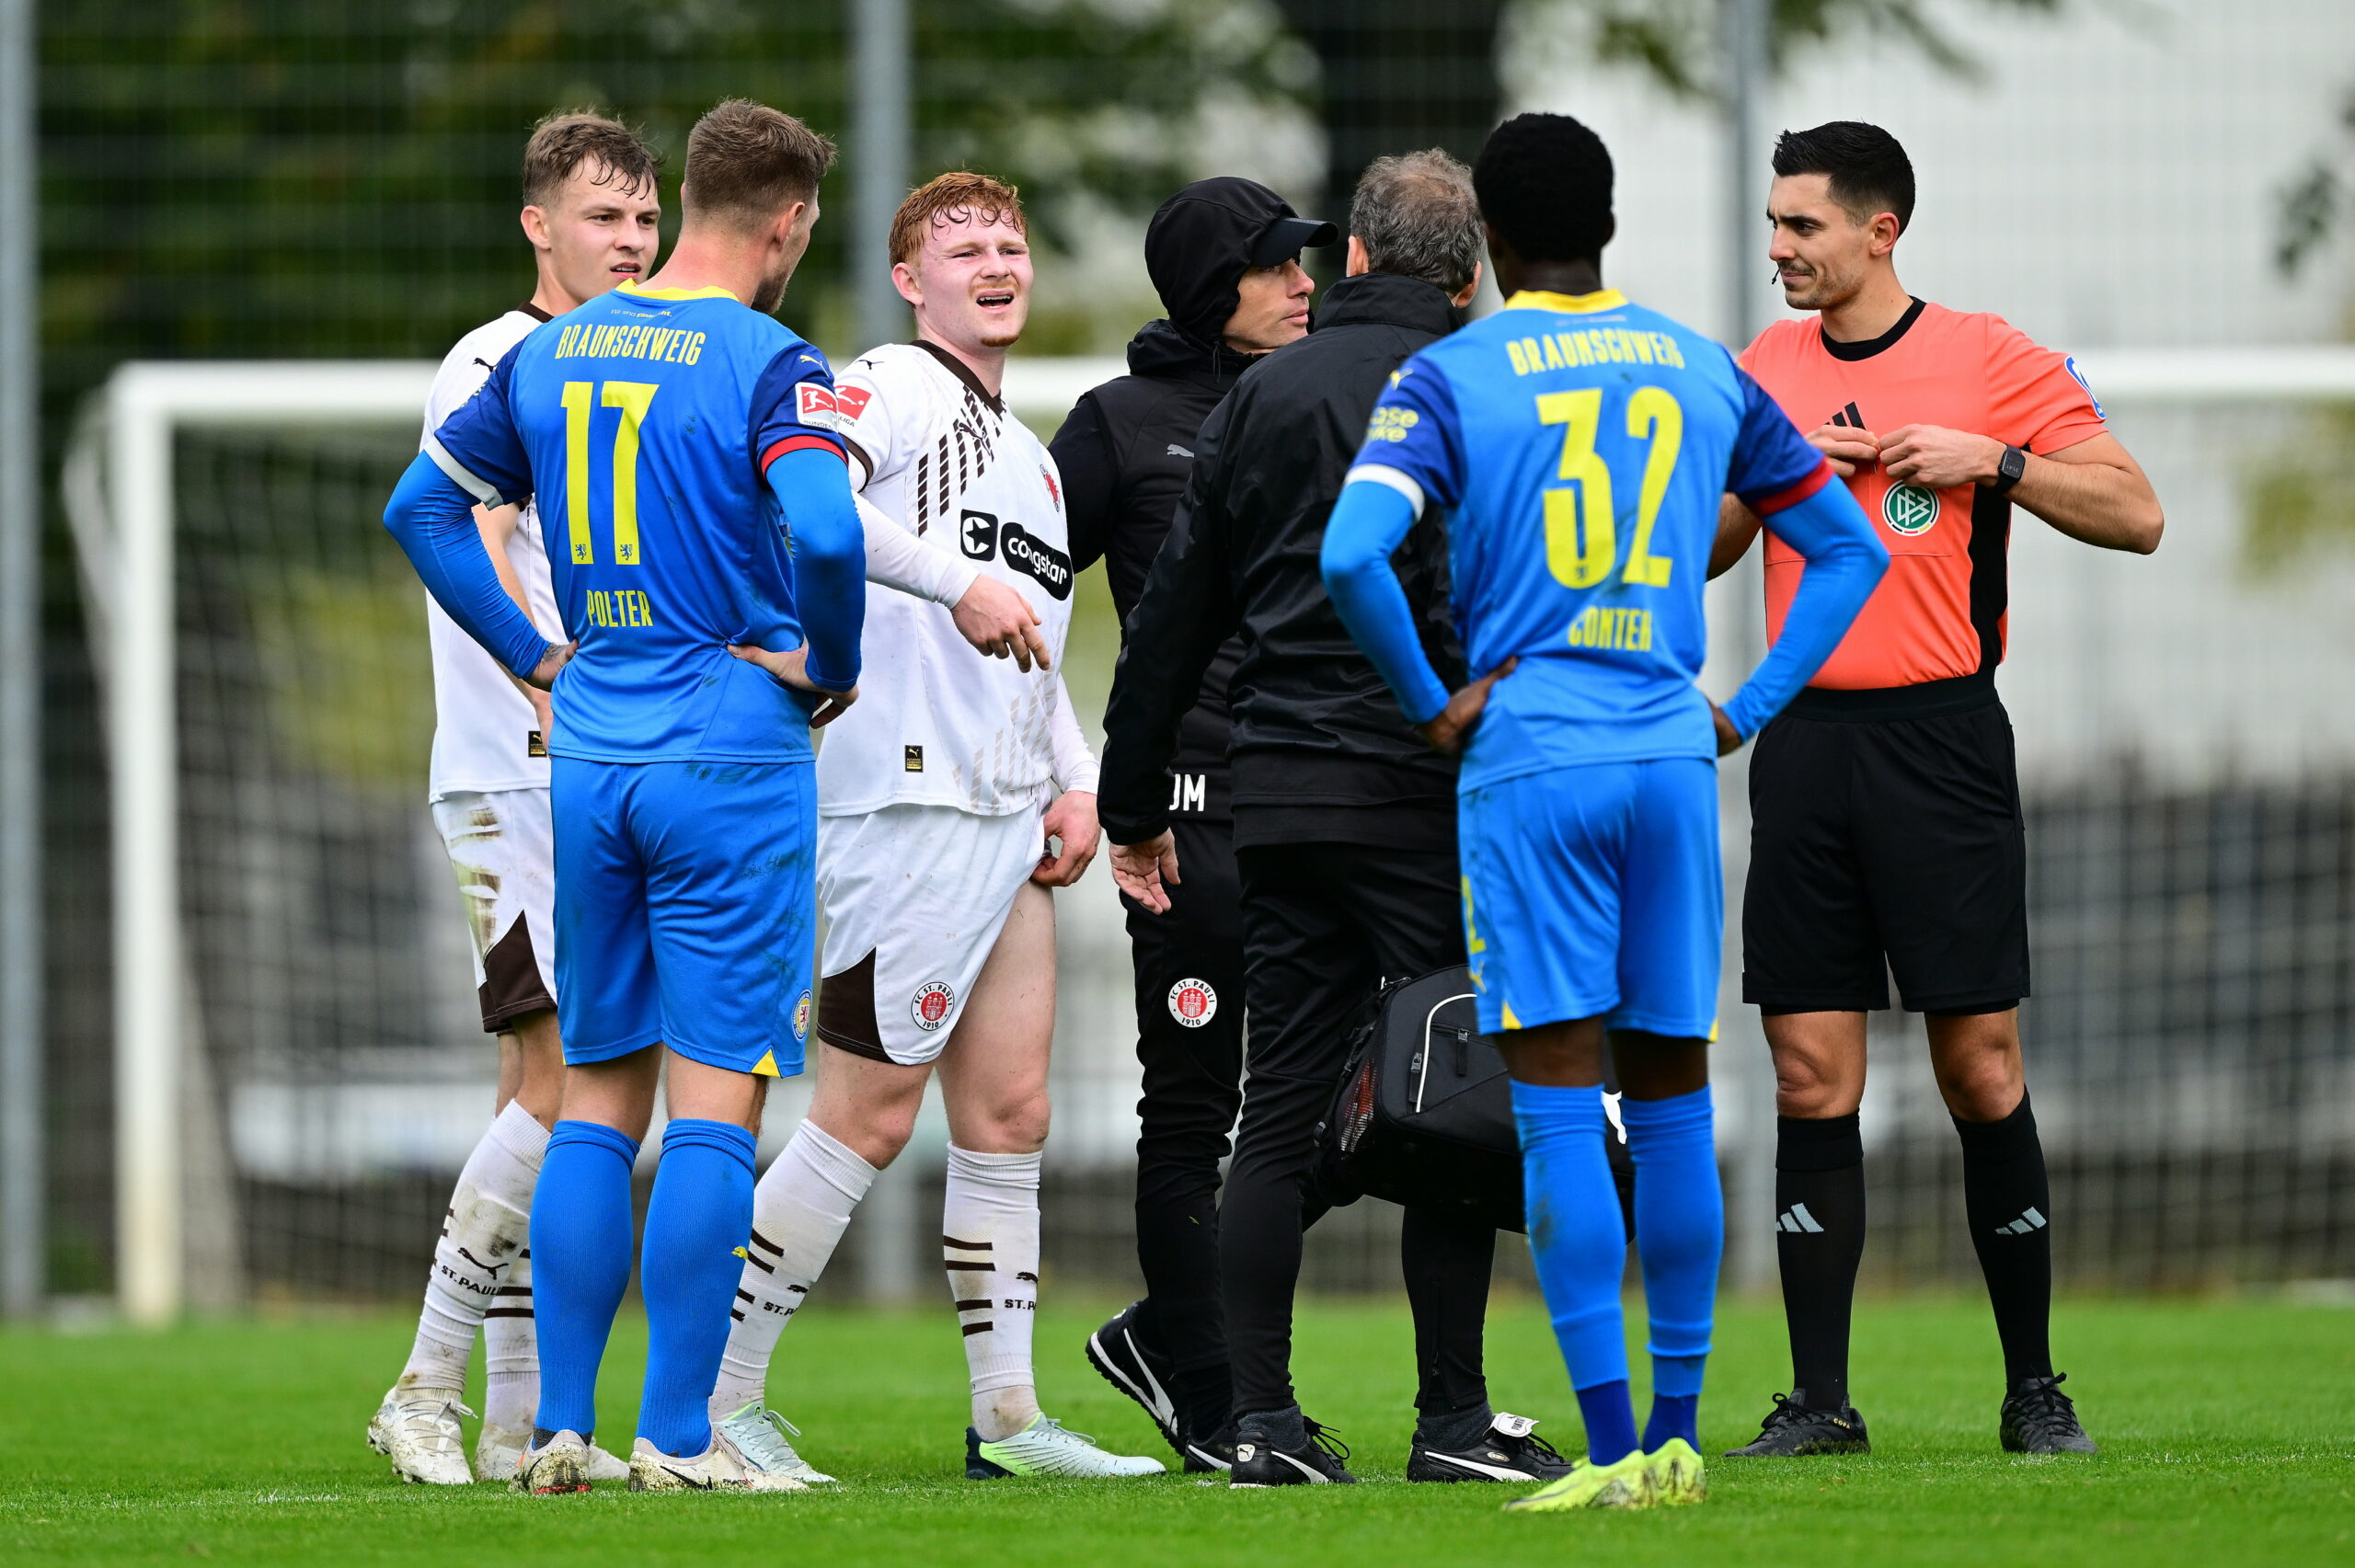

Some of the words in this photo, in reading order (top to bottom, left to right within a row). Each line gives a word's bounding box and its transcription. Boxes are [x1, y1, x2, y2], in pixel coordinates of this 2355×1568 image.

[555, 324, 706, 366] BRAUNSCHWEIG
[560, 381, 660, 566] 17
[1535, 386, 1683, 589] 32
[587, 589, 653, 628] POLTER
[1168, 773, 1206, 811] JM
[914, 994, 923, 1004] FC
[924, 985, 936, 994] ST.
[937, 984, 953, 1006] PAULI
[1170, 990, 1178, 1000] FC
[1178, 980, 1189, 990] ST.
[1193, 980, 1215, 1003] PAULI
[923, 1021, 939, 1029] 1910
[1181, 1017, 1201, 1026] 1910
